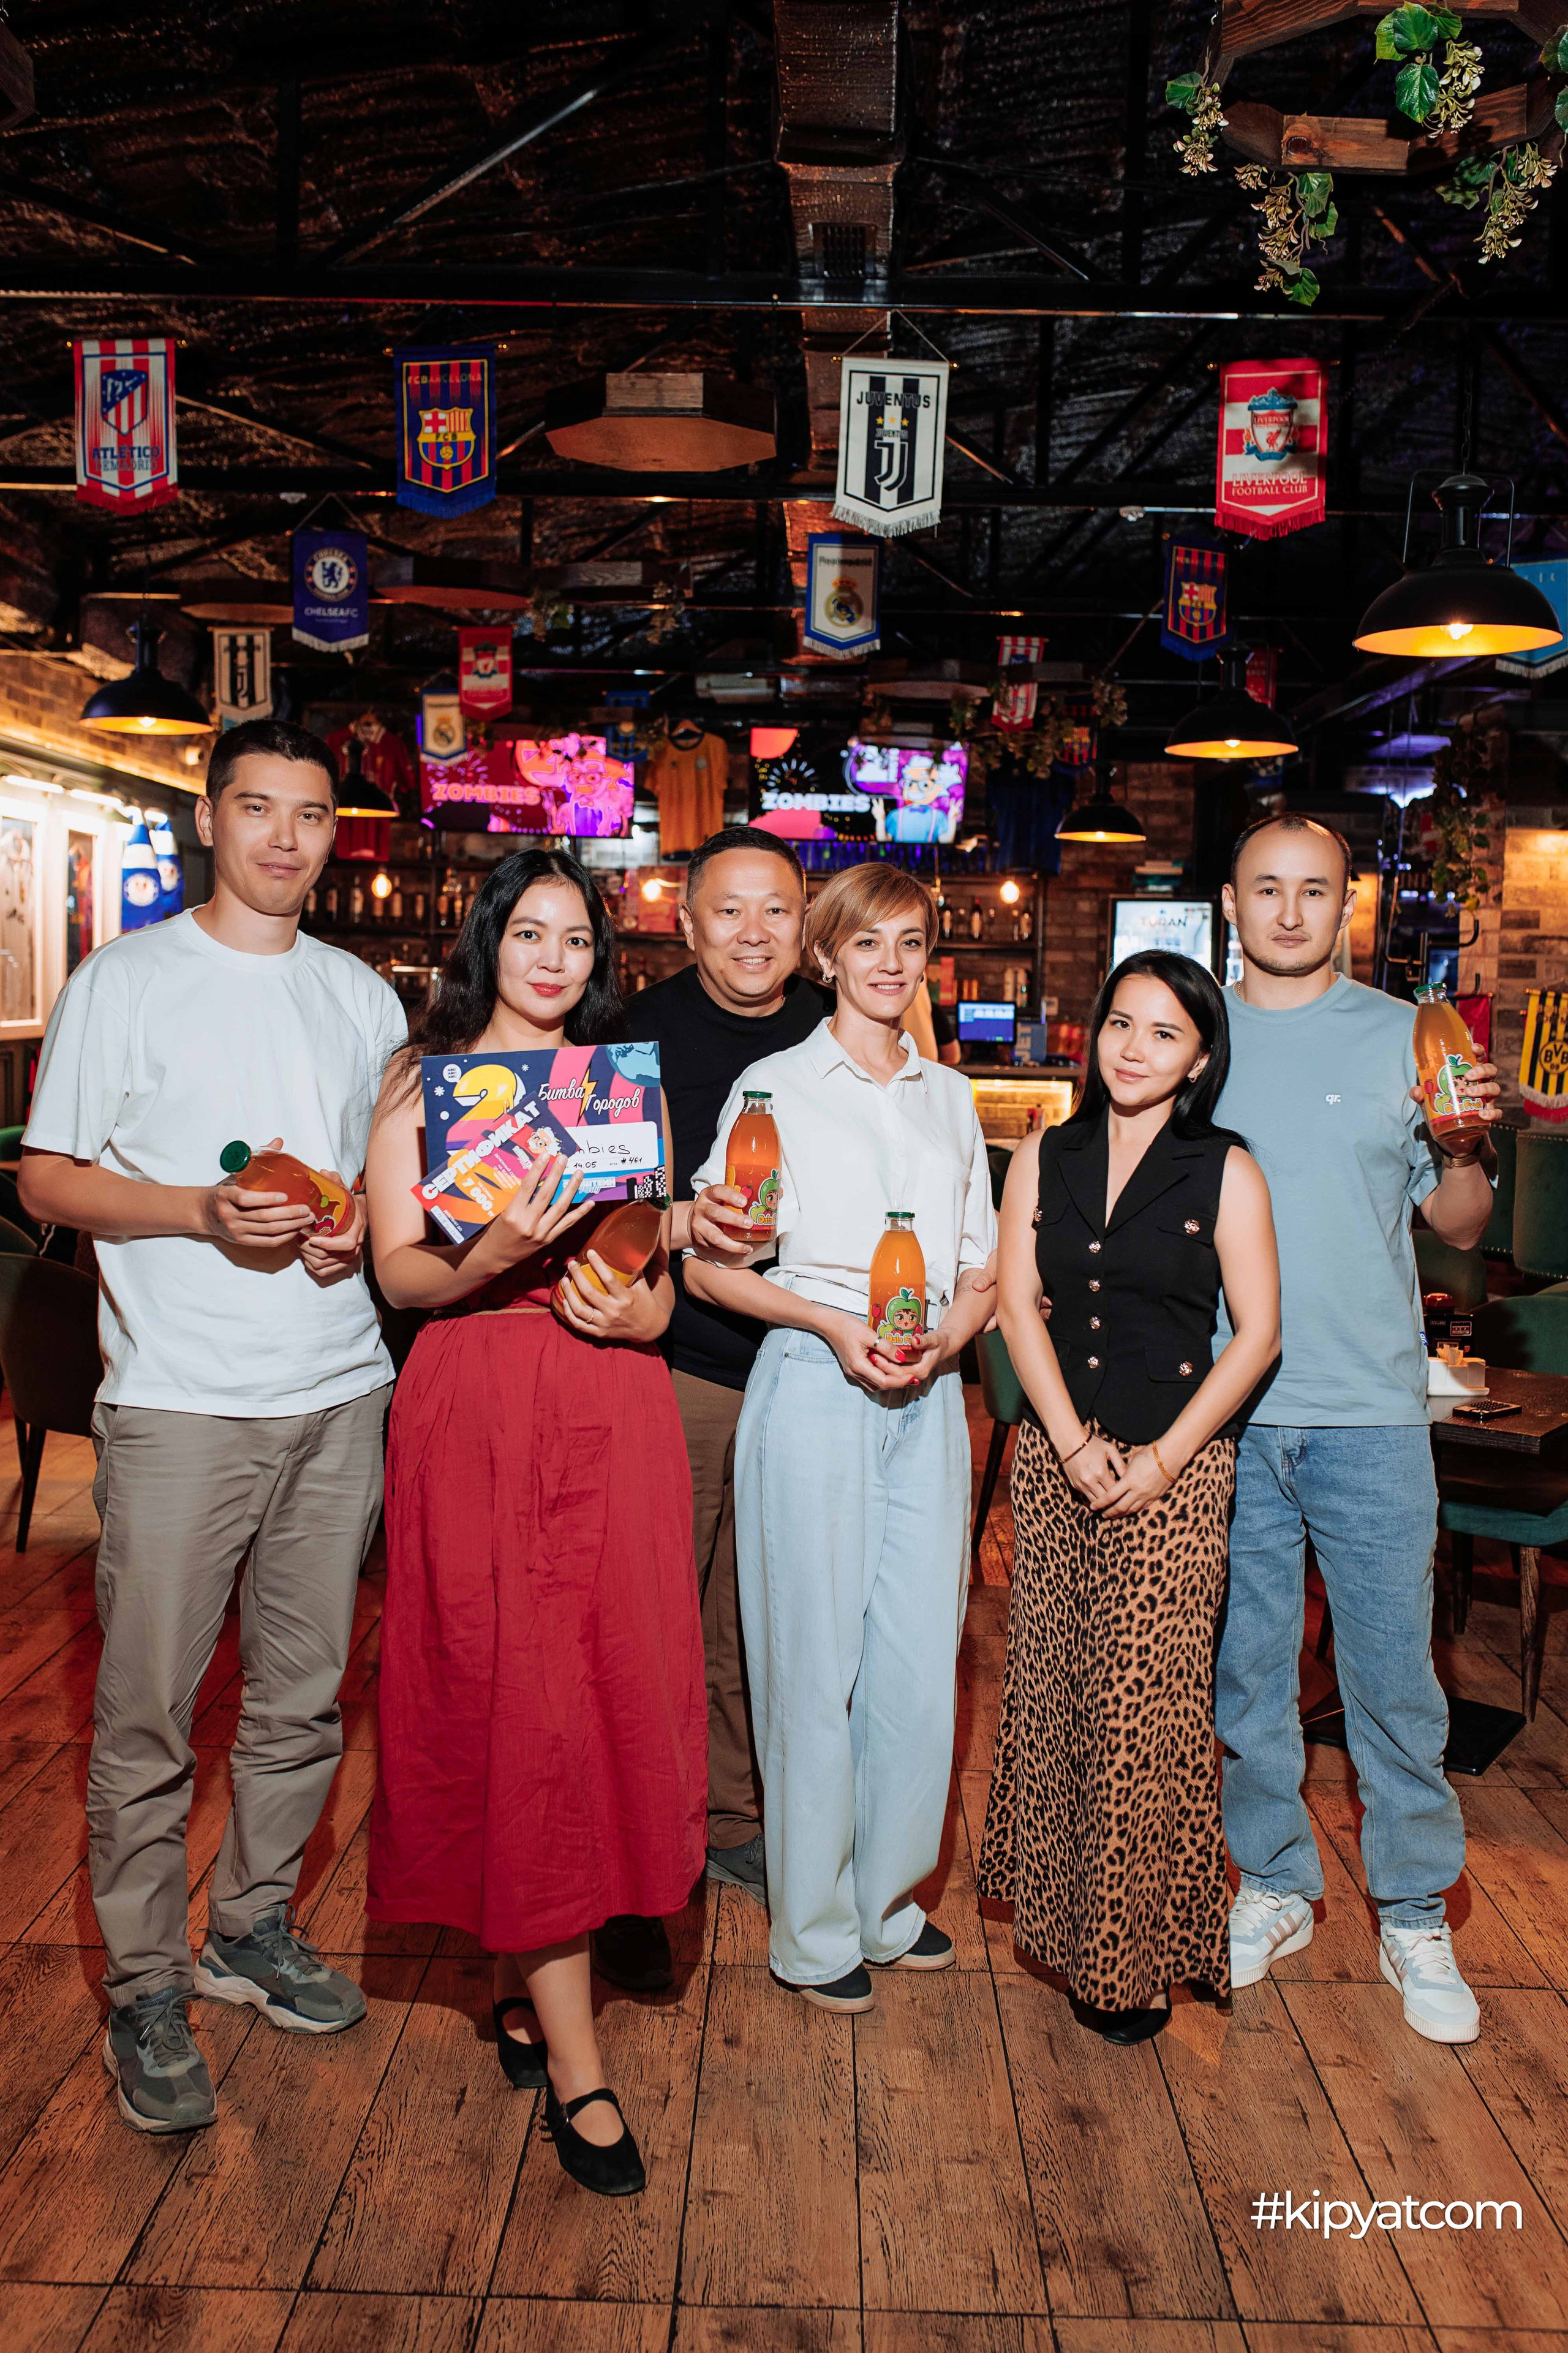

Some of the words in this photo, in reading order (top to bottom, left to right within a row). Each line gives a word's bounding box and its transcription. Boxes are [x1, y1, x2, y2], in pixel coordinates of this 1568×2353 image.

[857, 391, 930, 408] JUVENTUS
[1232, 470, 1308, 487] LIVERPOOL
[1232, 486, 1280, 497] FOOTBALL
[1283, 485, 1308, 494] CLUB
[432, 782, 541, 806] ZOMBIES
[761, 791, 871, 813] ZOMBIES
[538, 1078, 586, 1101] Битва
[585, 1087, 641, 1118] Городов
[1464, 1100, 1483, 1111] Fruit
[422, 1101, 540, 1200] СЕРТИФИКАТ
